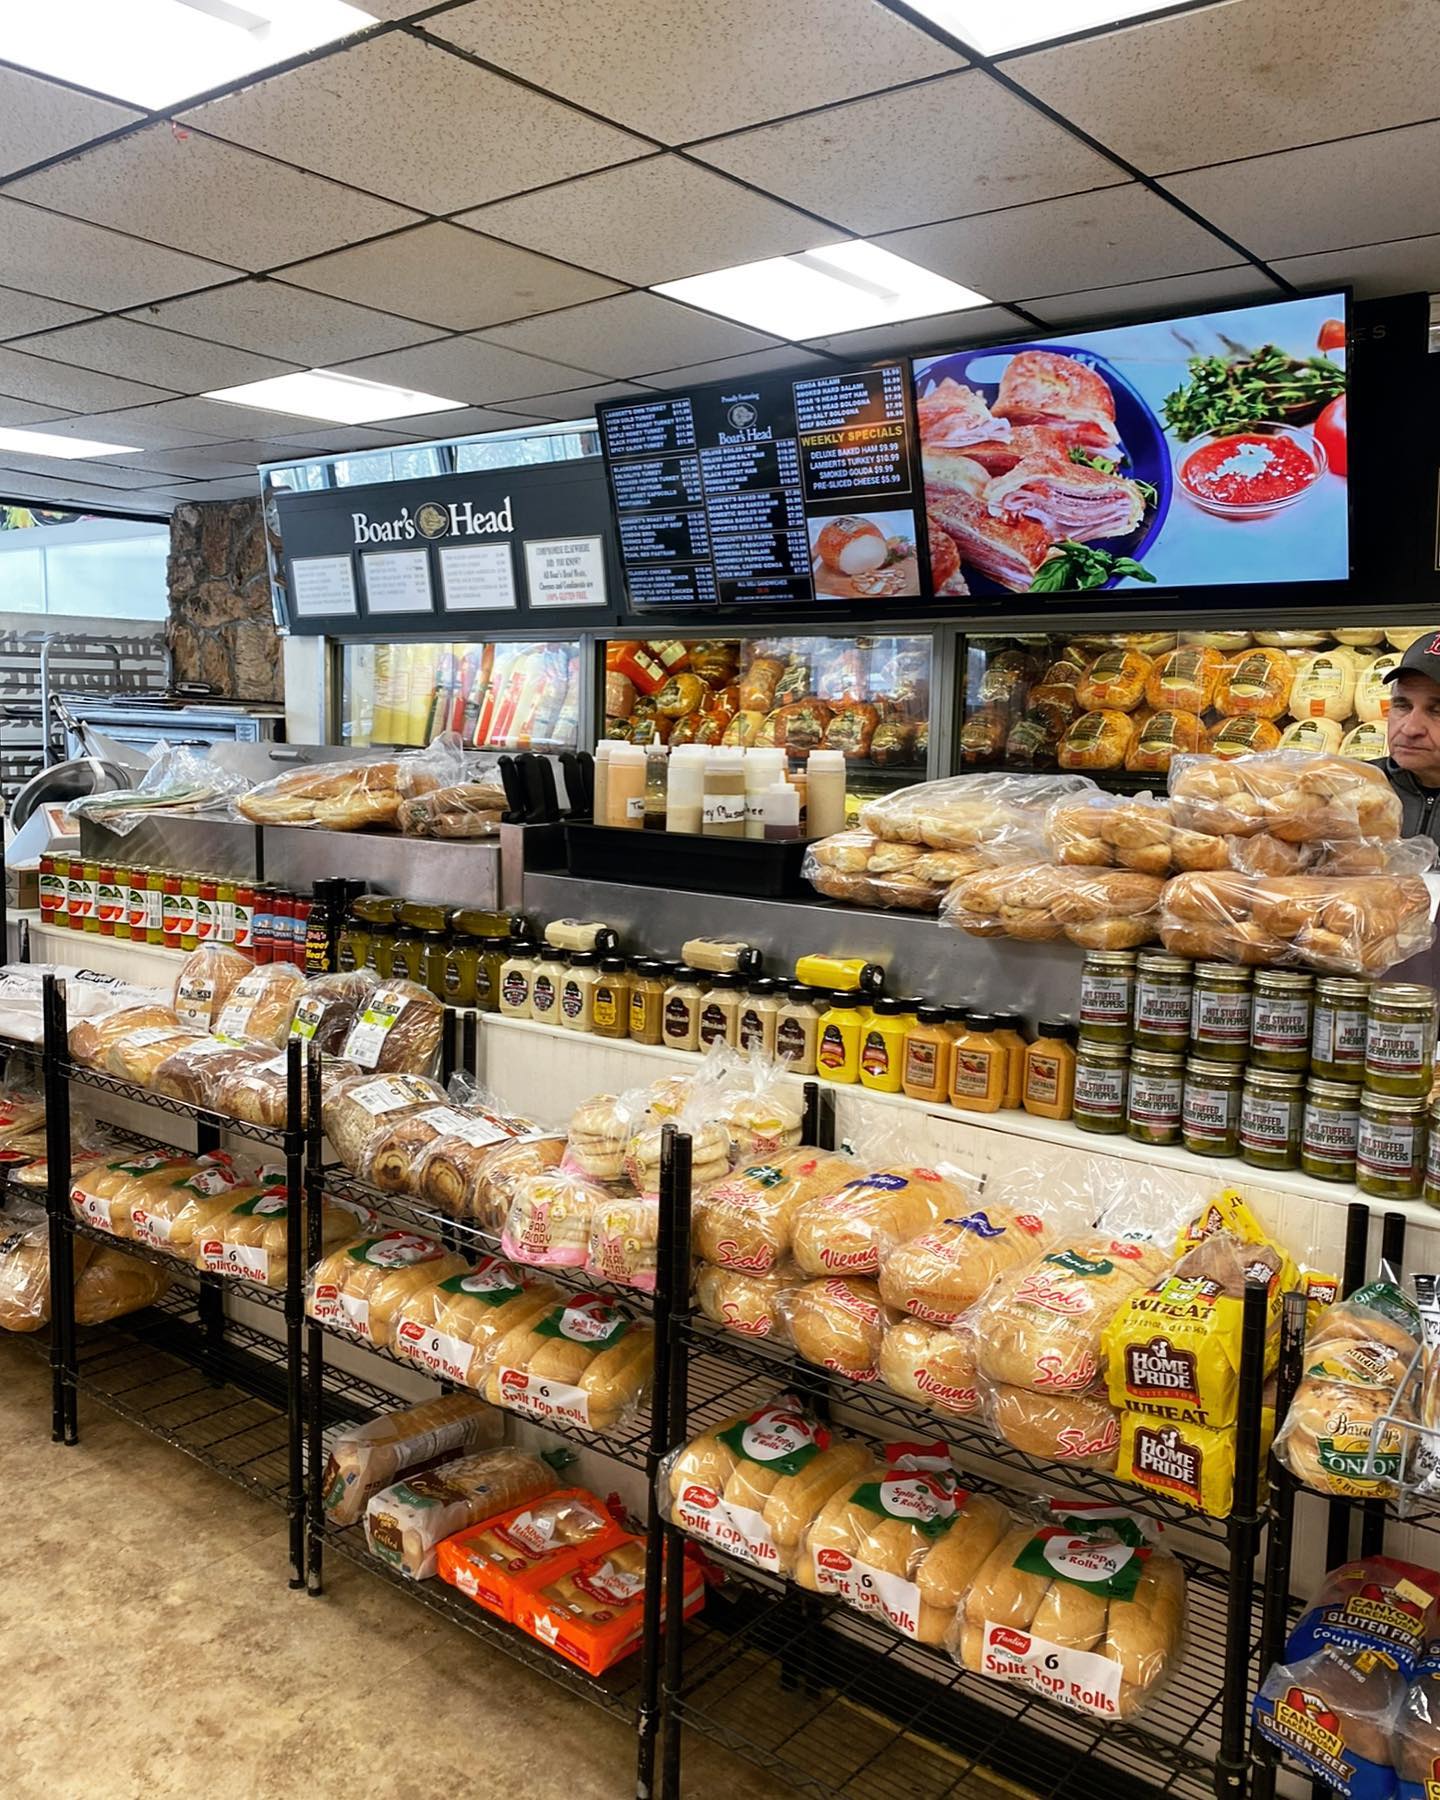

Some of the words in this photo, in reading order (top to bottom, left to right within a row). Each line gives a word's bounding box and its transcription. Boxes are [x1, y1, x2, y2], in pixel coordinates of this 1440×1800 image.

[746, 425, 773, 441] Head
[801, 432, 845, 447] WEEKLY
[848, 426, 902, 441] SPECIALS
[810, 449, 838, 459] DELUXE
[837, 447, 860, 457] BAKED
[861, 444, 878, 454] HAM
[878, 442, 898, 452] $9.99
[848, 455, 875, 465] TURKEY
[819, 470, 848, 479] SMOKED
[848, 467, 873, 476] GOUDA
[874, 464, 894, 474] $9.99
[813, 479, 852, 490] PRE-SLICED
[853, 476, 881, 486] CHEESE
[351, 507, 416, 544] Boar's
[448, 496, 514, 536] Head
[1094, 992, 1121, 1000] STUFFED
[1099, 1000, 1125, 1009] PEPPERS
[1160, 1000, 1187, 1009] STUFFED
[1162, 1008, 1190, 1018] PEPPERS
[1220, 1008, 1249, 1018] STUFFED
[1226, 1016, 1251, 1026] PEPPERS
[1272, 1016, 1301, 1025] STUFFED
[1278, 1024, 1305, 1033] PEPPERS
[1382, 1039, 1415, 1049] STUFFED
[1388, 1048, 1419, 1059] PEPPERS
[1090, 1083, 1115, 1092] STUFFED
[1093, 1091, 1119, 1100] PEPPERS
[1147, 1093, 1175, 1103] STUFFED
[1153, 1101, 1179, 1110] PEPPERS
[1192, 1102, 1219, 1113] STUFFED
[1196, 1112, 1224, 1123] PEPPERS
[1253, 1114, 1281, 1125] STUFFED
[1256, 1123, 1285, 1135] PEPPERS
[1321, 1125, 1351, 1136] STUFFED
[1326, 1133, 1356, 1145] PEPPERS
[1372, 1139, 1404, 1151] STUFFED
[1377, 1149, 1409, 1161] PEPPERS
[229, 1250, 237, 1262] 6
[820, 1246, 879, 1269] Vienna
[824, 1278, 879, 1318] Vienna
[431, 1337, 440, 1351] 6
[421, 1351, 441, 1369] Top
[442, 1362, 465, 1381] Rolls
[1132, 1352, 1189, 1376] HOME
[913, 1368, 977, 1401] Vienna
[1133, 1369, 1191, 1389] PRIDE
[539, 1385, 551, 1398] 6
[501, 1388, 529, 1405] Split
[531, 1396, 553, 1416] Top
[556, 1405, 587, 1425] Rolls
[1124, 1400, 1210, 1425] WHEAT
[1141, 1435, 1195, 1470] HOME
[1140, 1452, 1195, 1485] PRIDE
[679, 1508, 710, 1532] Split
[714, 1520, 741, 1543] Top
[1068, 1555, 1099, 1571] Rolls
[861, 1573, 873, 1588] 6
[1350, 1606, 1417, 1633] BAKEHOUSE
[1352, 1598, 1420, 1628] CANYON
[1327, 1611, 1389, 1635] GLUTEN
[1044, 1653, 1059, 1670] 6
[985, 1654, 1028, 1675] Split
[1031, 1664, 1065, 1692] Top
[1070, 1682, 1116, 1713] Rolls
[1280, 1706, 1338, 1748] CANYON
[1280, 1714, 1335, 1753] BAKEHOUSE
[1262, 1715, 1313, 1752] GLUTEN
[1315, 1747, 1349, 1776] FREE
[1311, 1764, 1352, 1797] White
